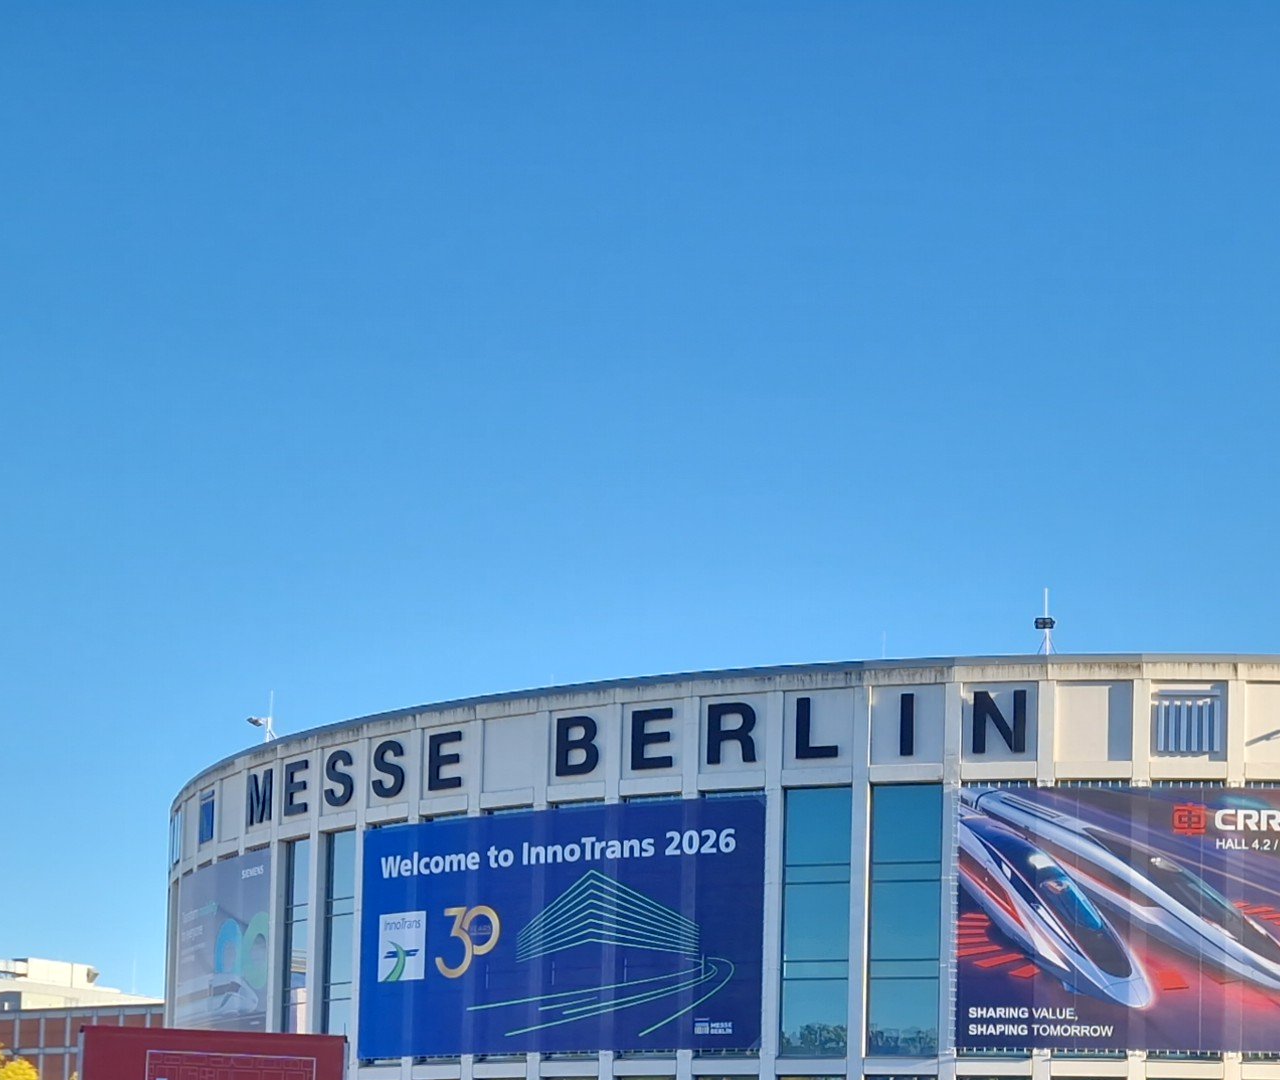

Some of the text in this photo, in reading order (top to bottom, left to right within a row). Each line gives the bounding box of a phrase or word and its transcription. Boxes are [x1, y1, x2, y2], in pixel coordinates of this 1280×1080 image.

[247, 690, 1026, 825] MESSE BERLIN
[1216, 838, 1247, 850] HALL
[1251, 838, 1269, 850] 4.2
[381, 828, 736, 879] Welcome to InnoTrans 2026
[241, 864, 265, 879] SIEMENS
[384, 918, 422, 932] InnoTrans
[435, 905, 500, 979] 30
[968, 1007, 1078, 1022] SHARING VALUE,
[968, 1024, 1114, 1037] SHAPING TOMORROW
